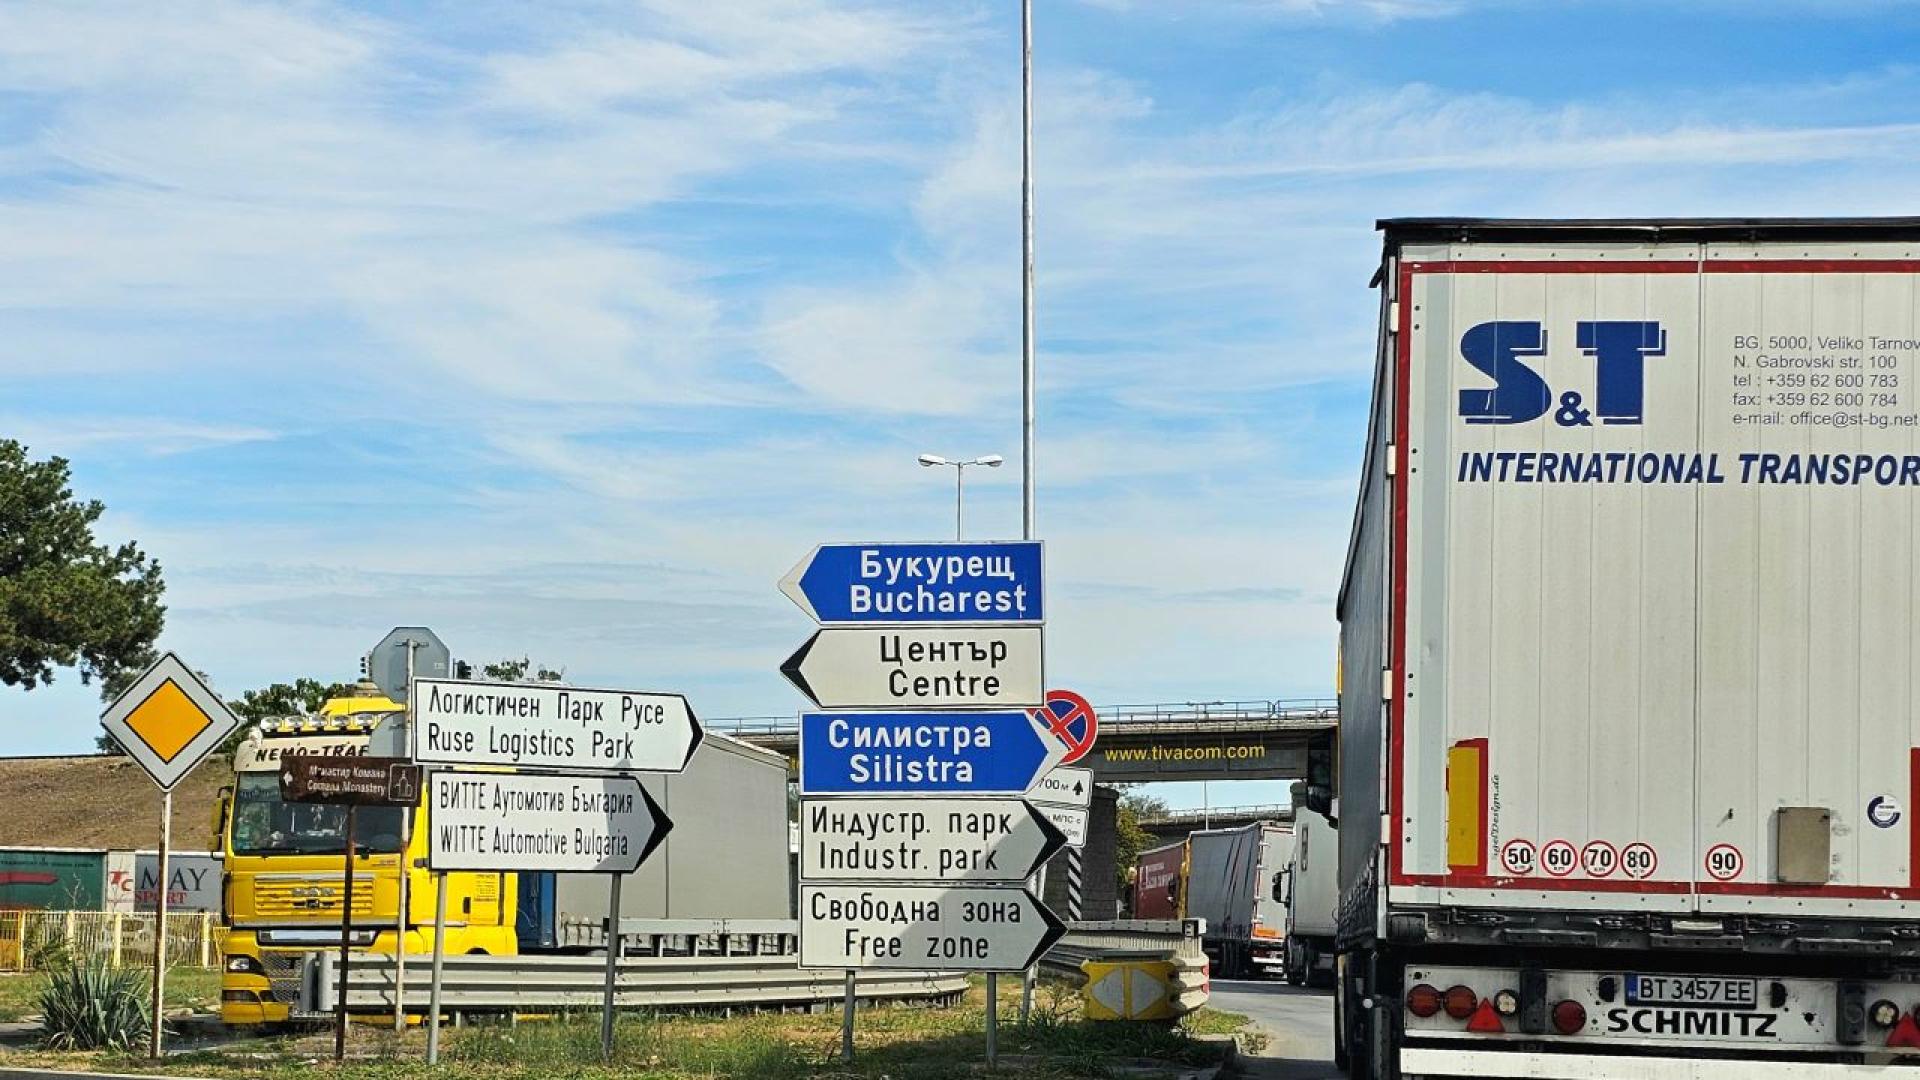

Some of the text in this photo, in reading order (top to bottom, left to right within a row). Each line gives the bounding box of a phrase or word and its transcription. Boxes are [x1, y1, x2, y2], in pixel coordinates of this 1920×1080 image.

[1733, 335, 1920, 351] BG, 5000, Veliko Tarnov
[1733, 354, 1897, 369] N. Gabrovski str. 100
[1766, 374, 1806, 388] +359
[1810, 374, 1830, 388] 62
[1835, 374, 1864, 388] 600
[1868, 374, 1899, 388] 783
[1733, 392, 1898, 406] fax: +359 62 600 784
[1732, 411, 1919, 428] e-mail: office@st-bg.net
[1457, 452, 1920, 486] INTERNATIONAL TRANSPOR
[860, 549, 1015, 585] Букурещ
[851, 583, 1027, 613] Bucharest
[880, 635, 1008, 669] Център
[889, 668, 1000, 697] Centre
[428, 685, 664, 730] Логистичен Парк Русе
[428, 722, 634, 762] Ruse Logistics Park
[828, 719, 991, 755] Силистра
[1105, 744, 1266, 761] www.tivacom.com
[308, 765, 350, 779] Мнастир
[850, 754, 973, 783] Silistra
[341, 780, 386, 797] Monastery
[440, 781, 633, 820] ВИТТЕ Аутомотив България
[811, 806, 1012, 840] Индустр. парк
[440, 825, 628, 862] WITTE Automotive Bulgaria
[1508, 847, 1531, 865] 50
[1548, 848, 1572, 866] 60
[819, 842, 998, 877] Industr. park
[1588, 849, 1612, 867] 70
[1626, 851, 1651, 868] 80
[1712, 852, 1737, 871] 90
[141, 866, 209, 891] MAY
[135, 890, 188, 904] SPRT
[811, 892, 1021, 924] Свободна зона
[845, 928, 989, 958] Free zone
[1640, 978, 1752, 1001] BT 3457 EE
[1607, 1008, 1778, 1038] SCHMITZ
